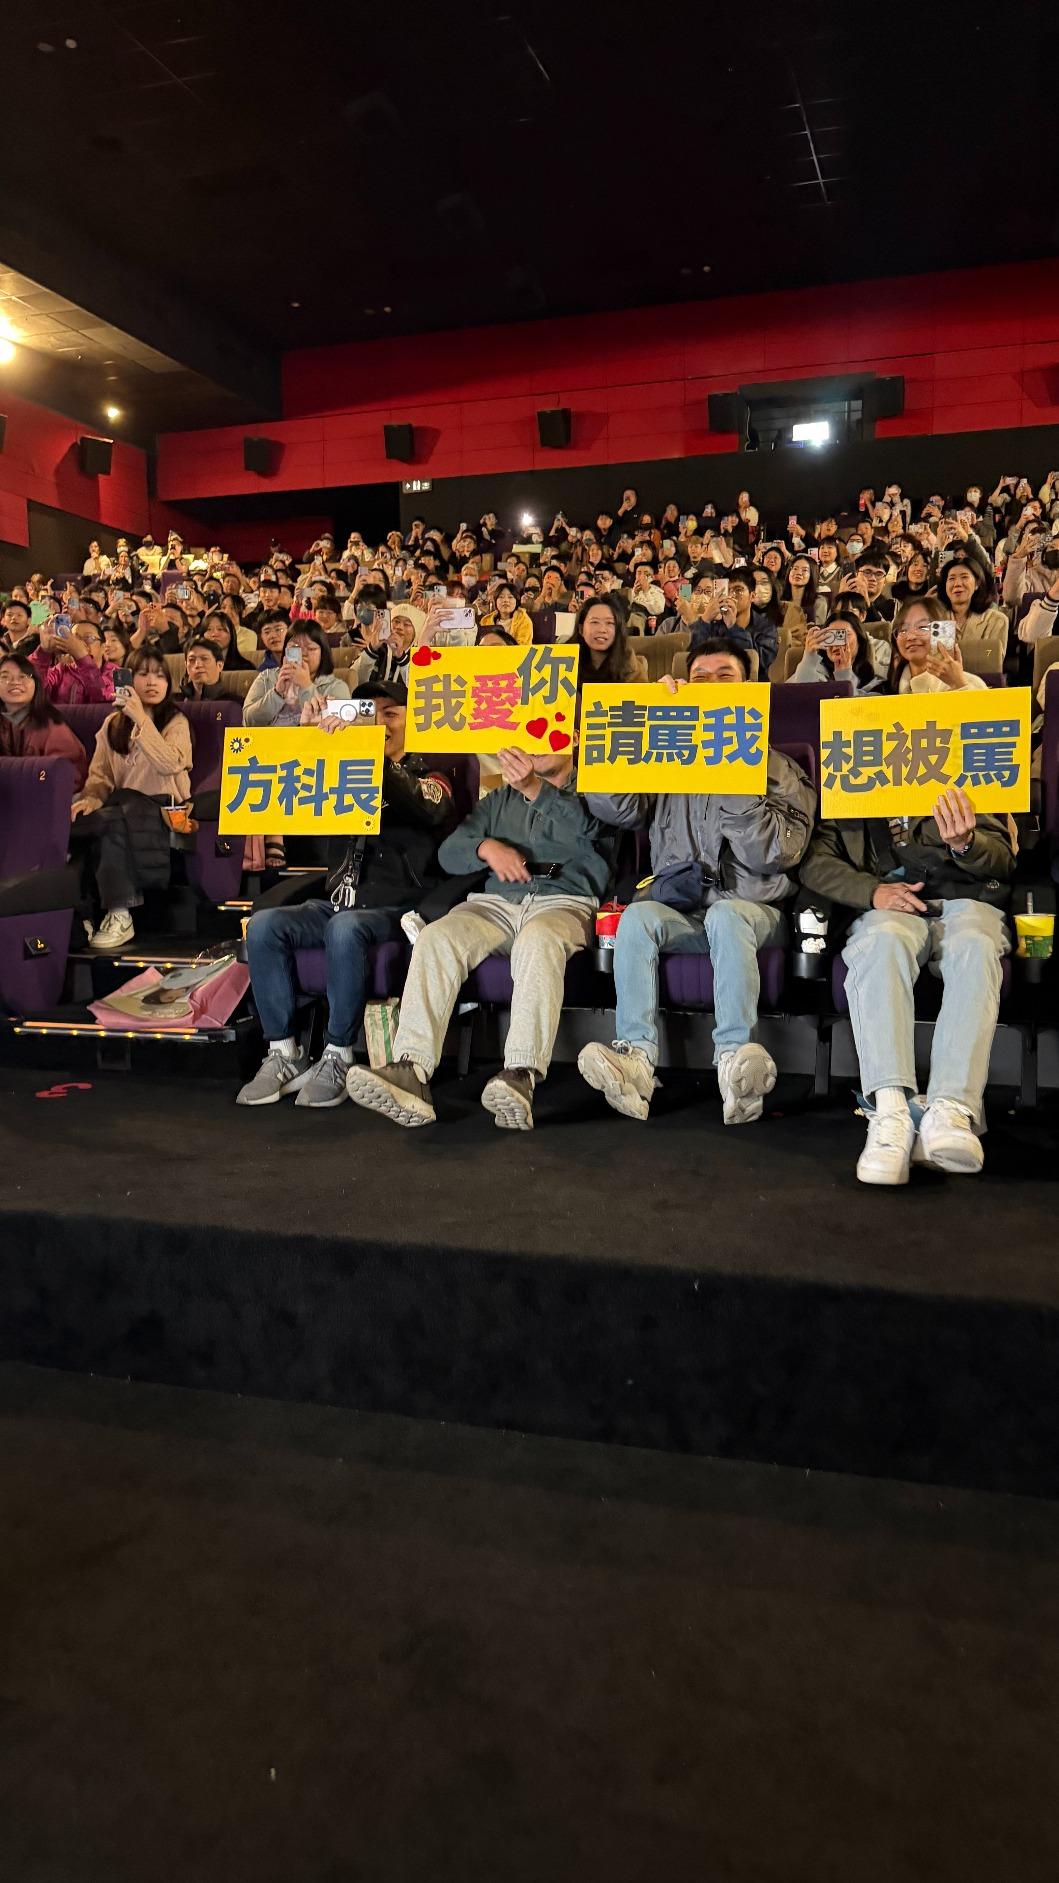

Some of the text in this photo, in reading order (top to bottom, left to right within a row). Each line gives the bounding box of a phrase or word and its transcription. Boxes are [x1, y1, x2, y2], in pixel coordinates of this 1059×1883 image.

[216, 711, 222, 721] 2
[413, 646, 577, 733] 我愛你
[585, 701, 764, 766] 請罵我
[821, 719, 1021, 794] 想被罵
[39, 770, 46, 781] 2
[226, 755, 380, 817] 方科長
